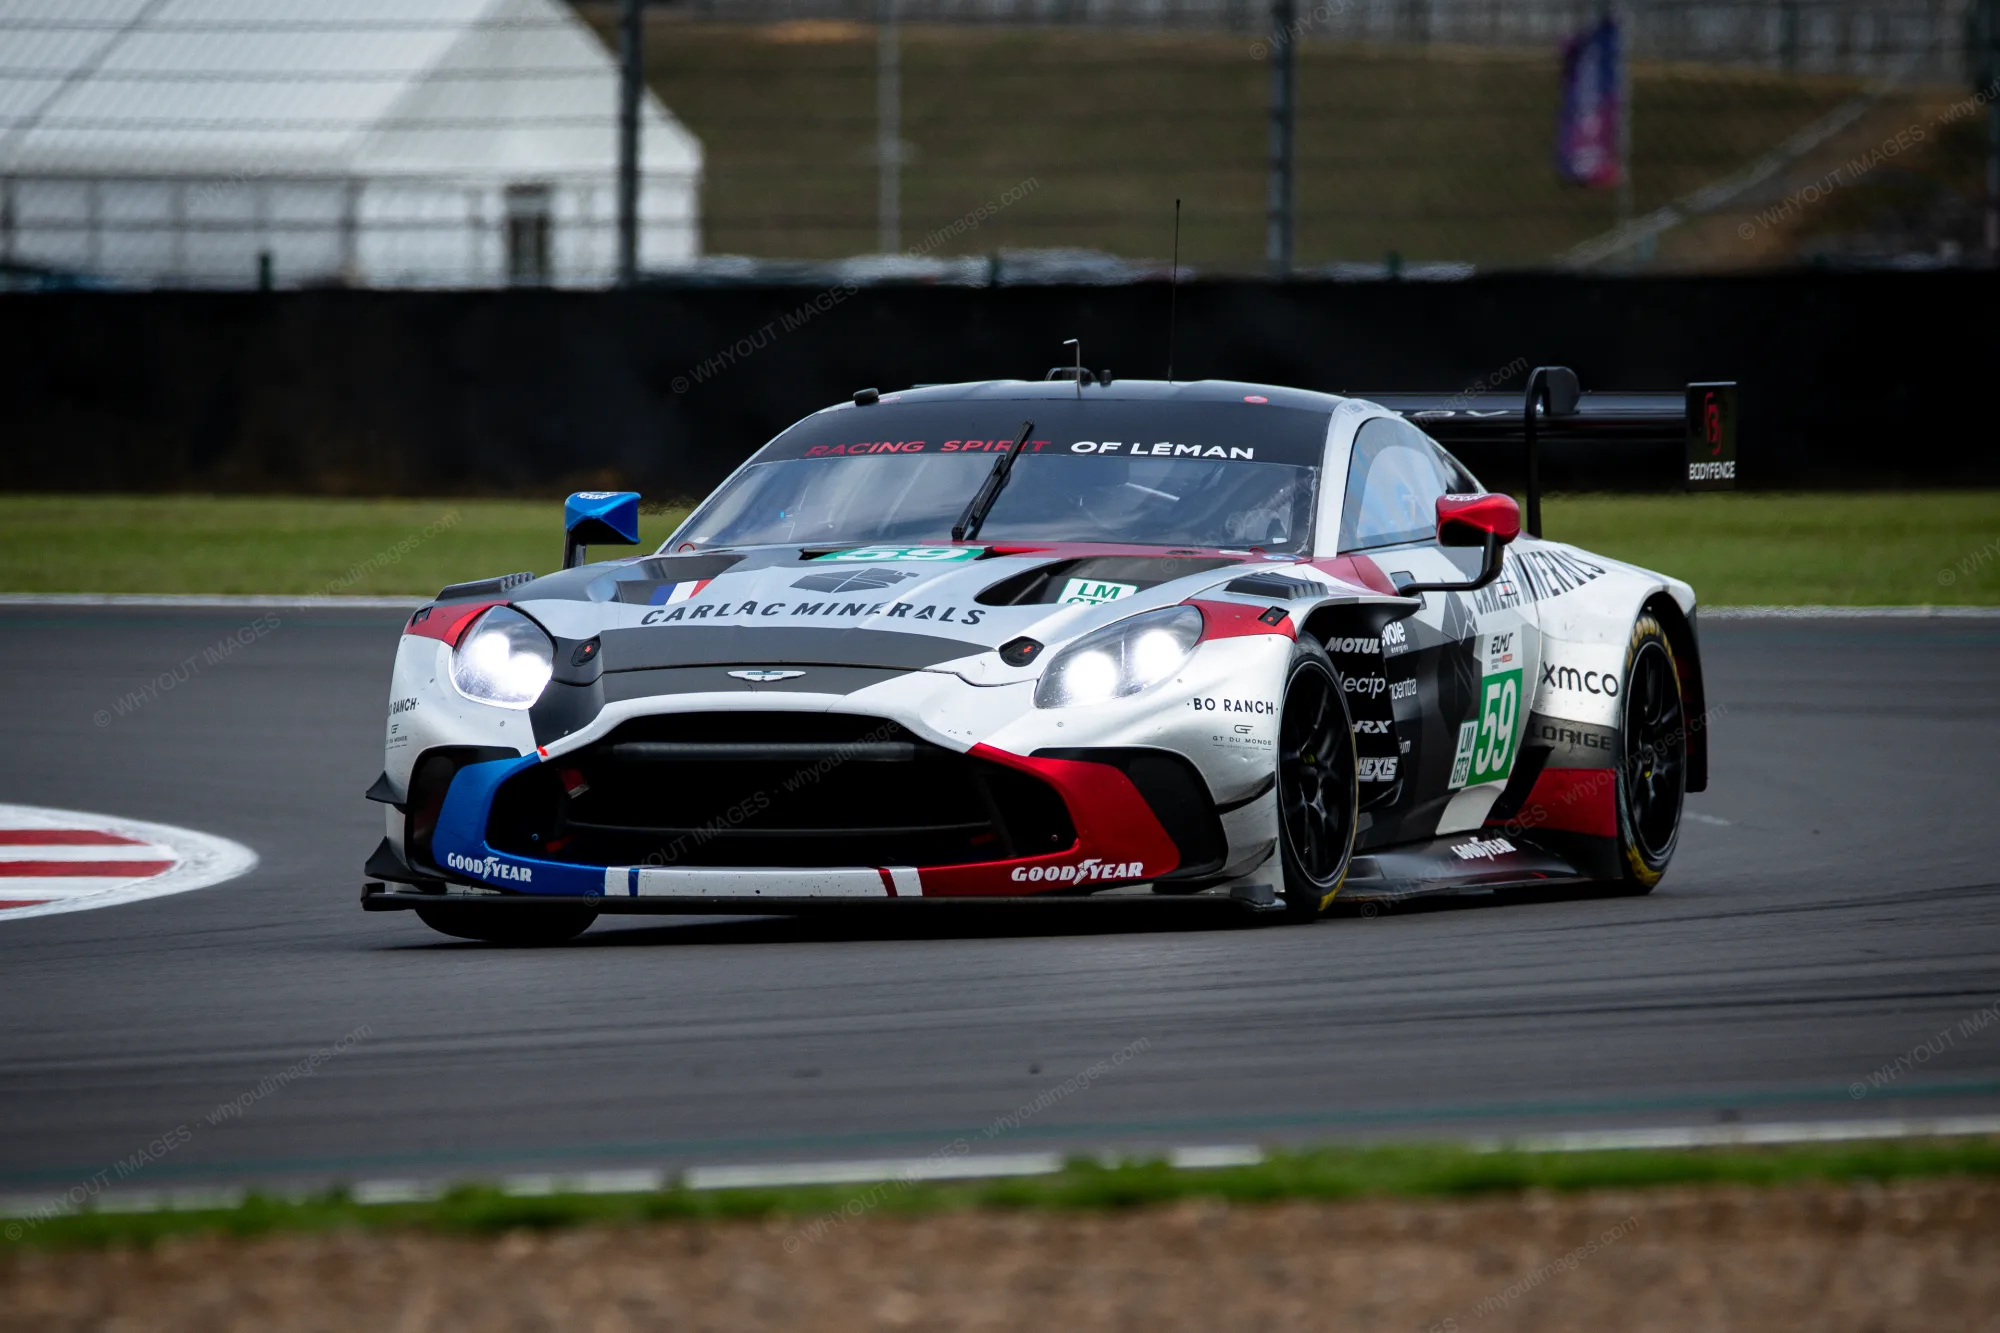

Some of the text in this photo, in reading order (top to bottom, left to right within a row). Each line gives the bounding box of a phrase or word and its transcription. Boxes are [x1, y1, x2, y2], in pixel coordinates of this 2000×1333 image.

[805, 440, 926, 458] RACING
[1070, 441, 1123, 455] OF
[1129, 441, 1256, 460] LÉMAN
[1689, 461, 1736, 480] BODYFENCE
[837, 548, 969, 561] 59
[1077, 582, 1122, 600] LM
[641, 600, 986, 626] CARLAC MINERALS
[1325, 636, 1381, 654] MOTUL
[1542, 661, 1619, 697] xmco
[1193, 697, 1274, 715] BO RANCH
[1475, 678, 1517, 776] 59
[1460, 724, 1475, 753] LM
